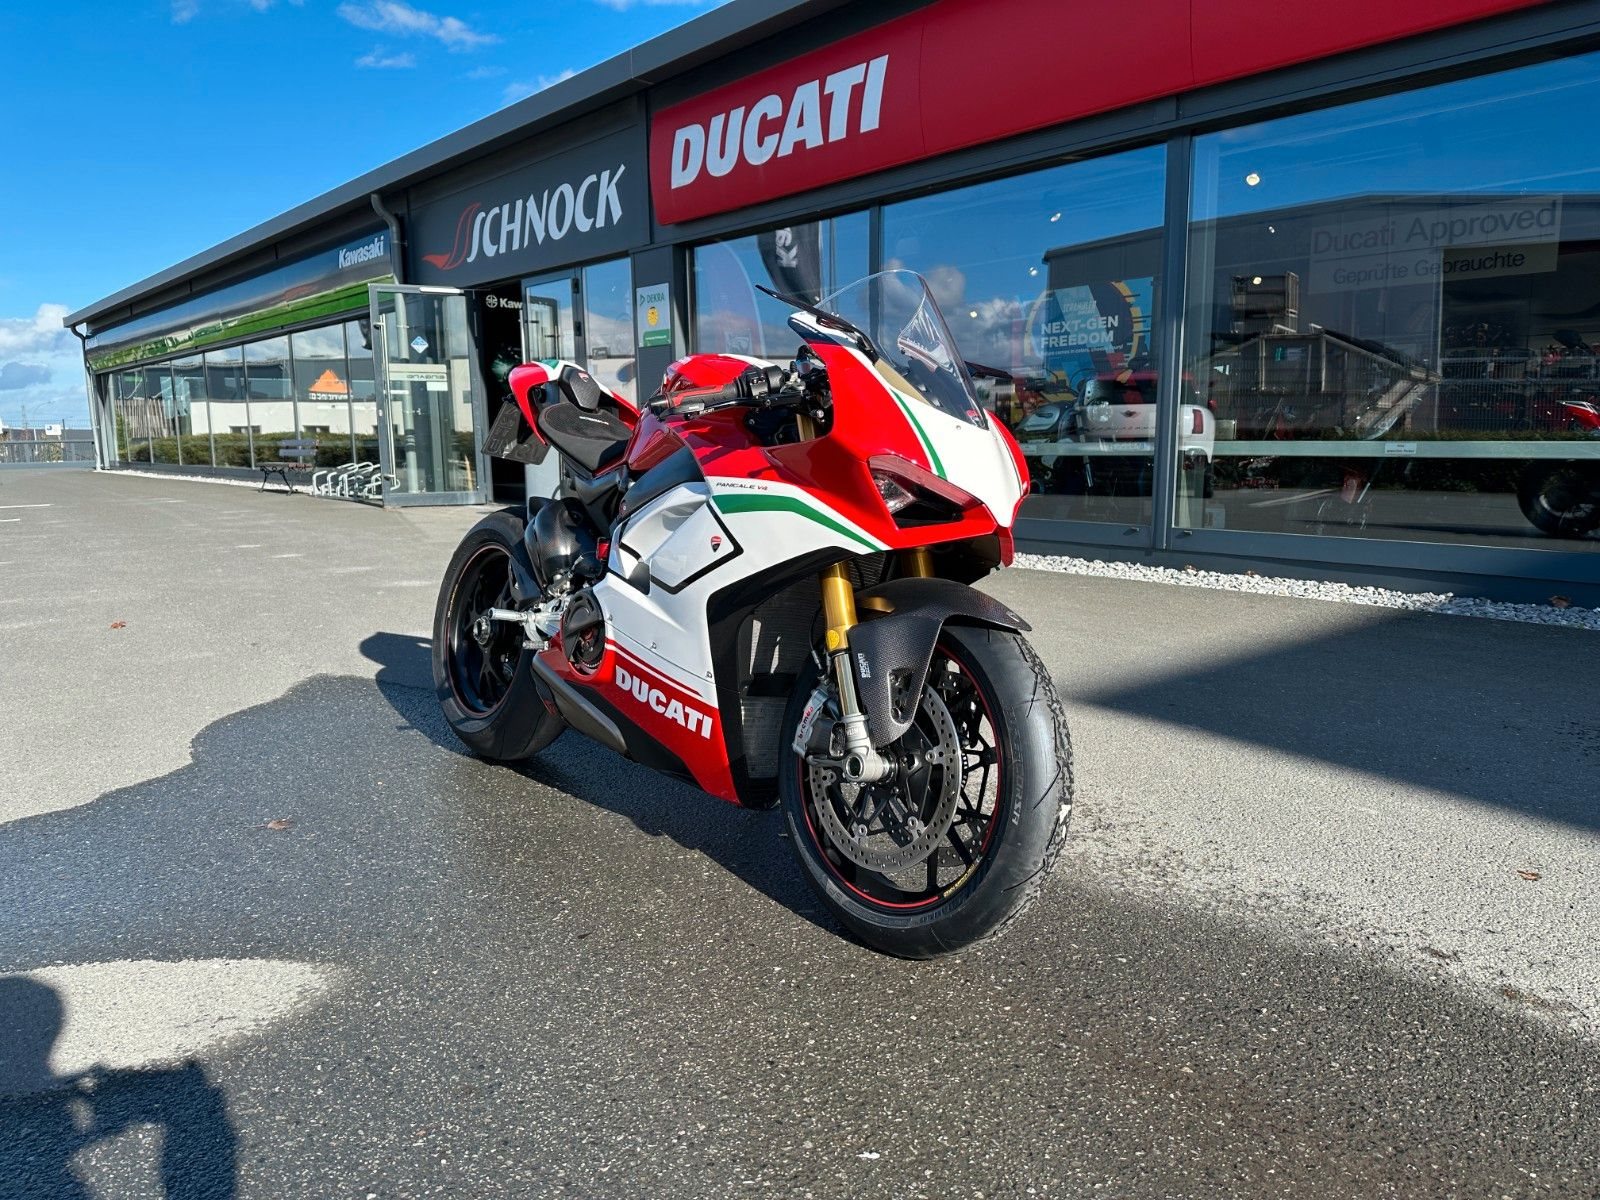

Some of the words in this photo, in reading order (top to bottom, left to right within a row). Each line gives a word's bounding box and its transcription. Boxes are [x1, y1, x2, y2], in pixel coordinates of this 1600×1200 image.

[671, 54, 889, 190] DUCATI
[466, 164, 626, 263] SCHNOCK
[1313, 221, 1395, 254] Ducati
[1406, 202, 1556, 246] Approved
[339, 235, 384, 269] Kawasaki
[1333, 261, 1408, 285] Geprüfte
[1415, 251, 1525, 276] Gebrauchte
[647, 292, 665, 304] DEKRA
[1041, 315, 1118, 335] NEXT-GEN
[1041, 330, 1114, 349] FREEDOM
[615, 665, 713, 740] DUCATI
[798, 706, 814, 739] brembo
